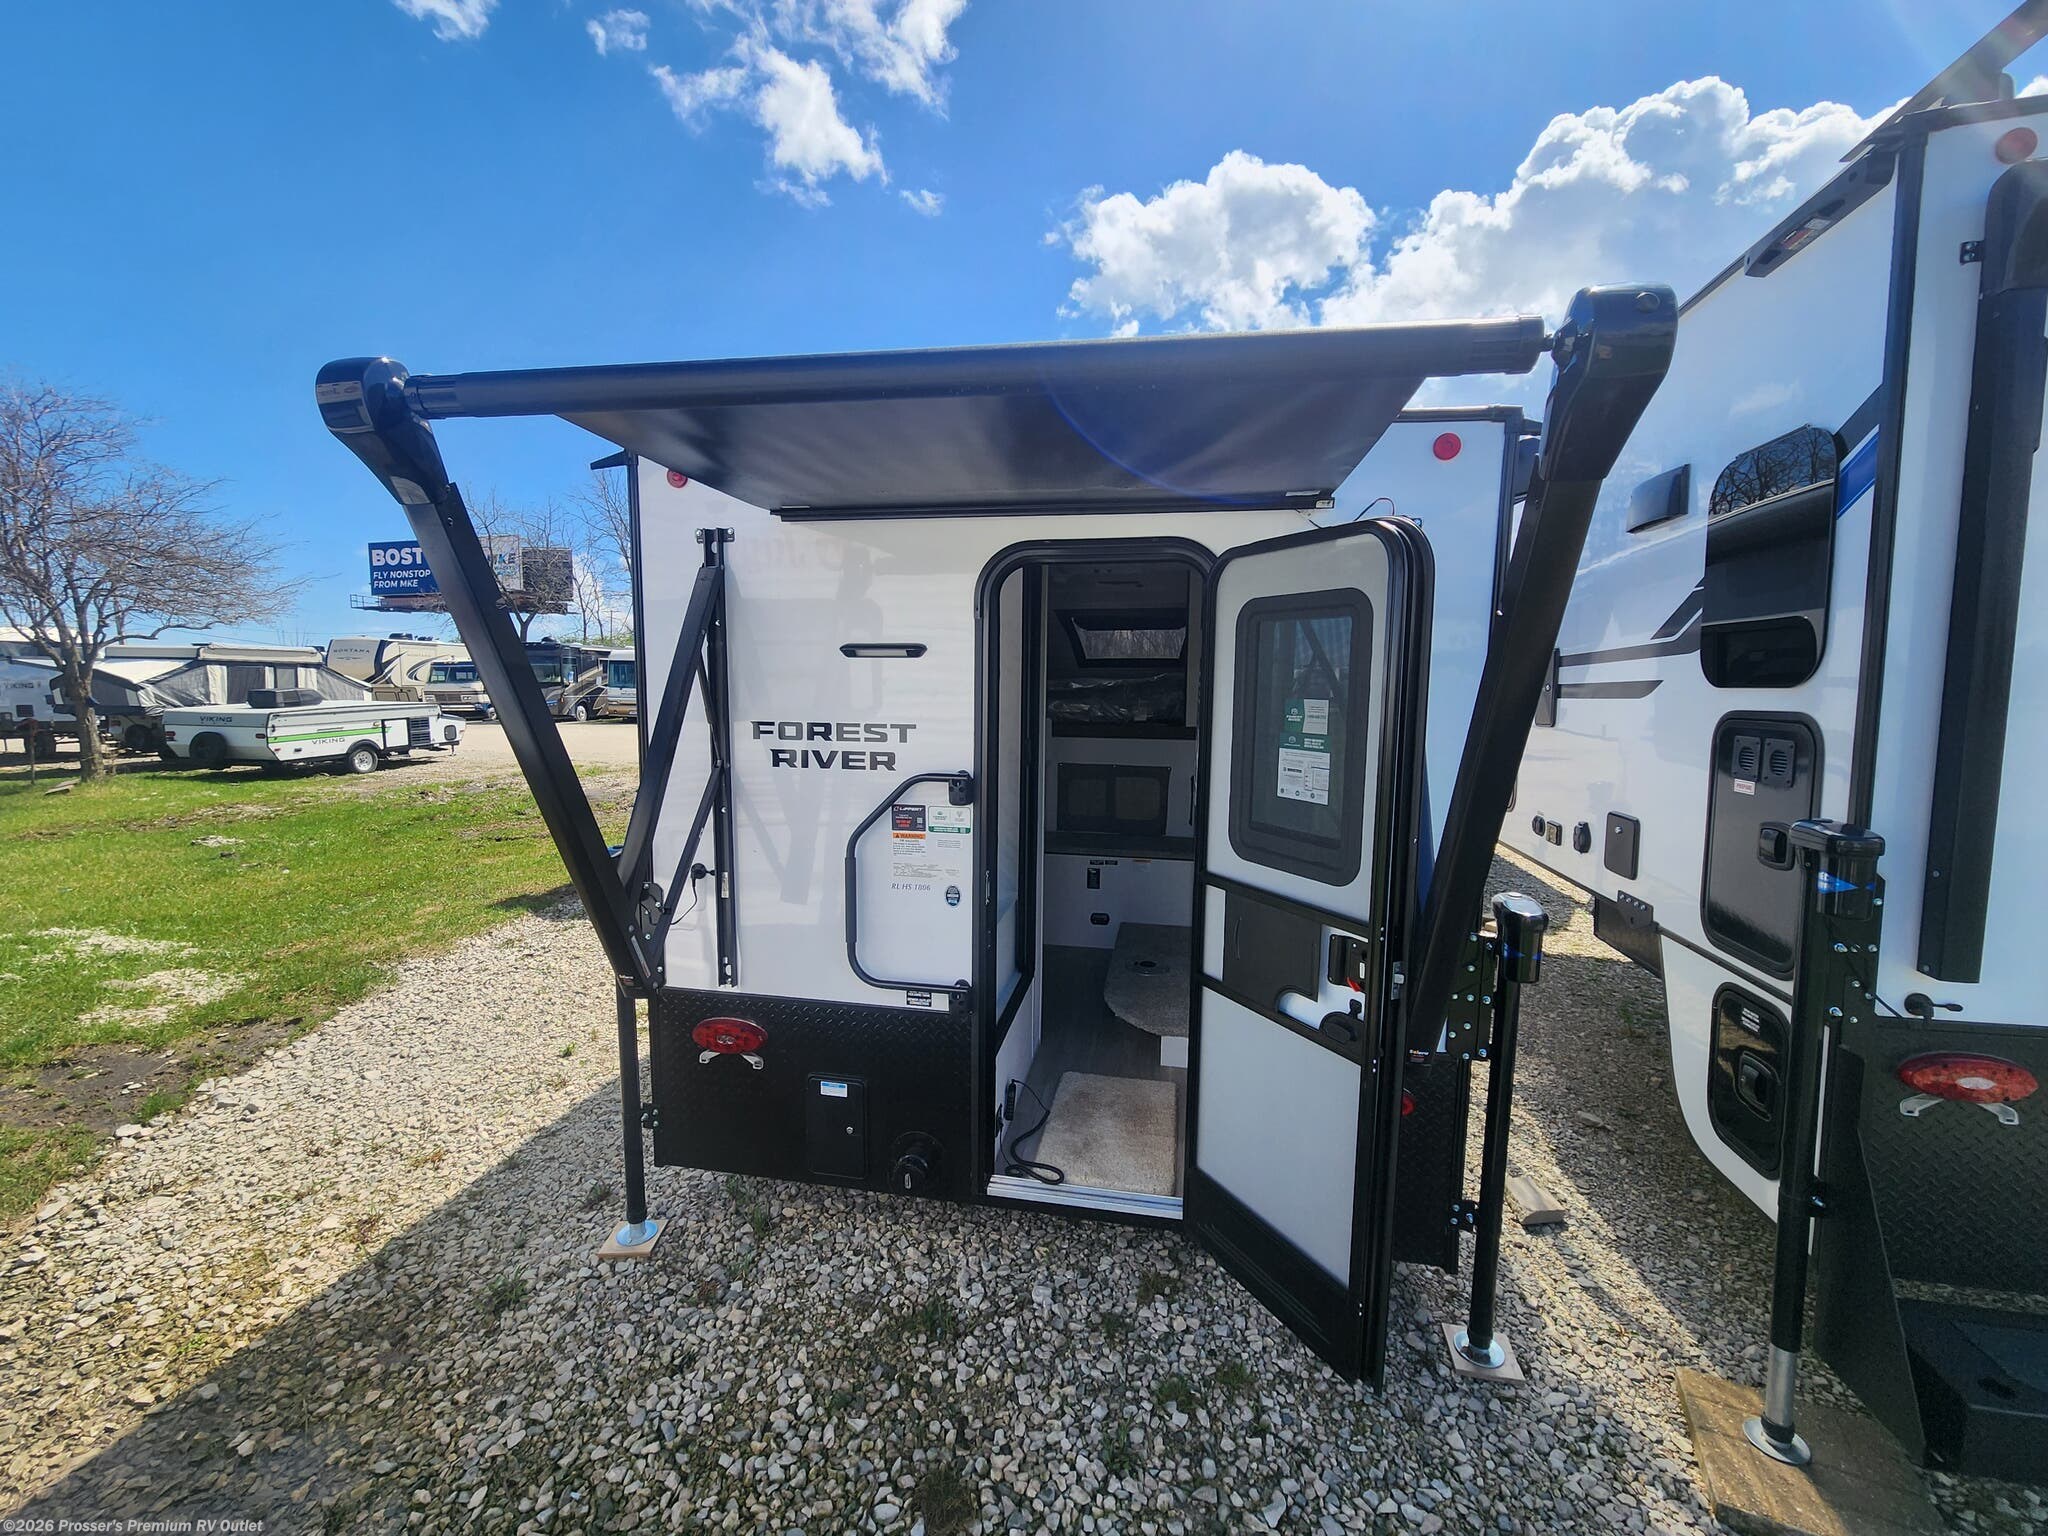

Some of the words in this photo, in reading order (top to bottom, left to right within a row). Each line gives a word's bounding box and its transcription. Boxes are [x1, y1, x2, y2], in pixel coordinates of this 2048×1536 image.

[372, 548, 423, 566] BOST
[373, 571, 389, 580] FLY
[389, 569, 432, 579] NONSTOP
[373, 580, 398, 589] FROM
[399, 579, 419, 588] MKE
[750, 721, 917, 743] FOREST
[311, 737, 346, 745] VIKING
[769, 748, 897, 771] RIVER
